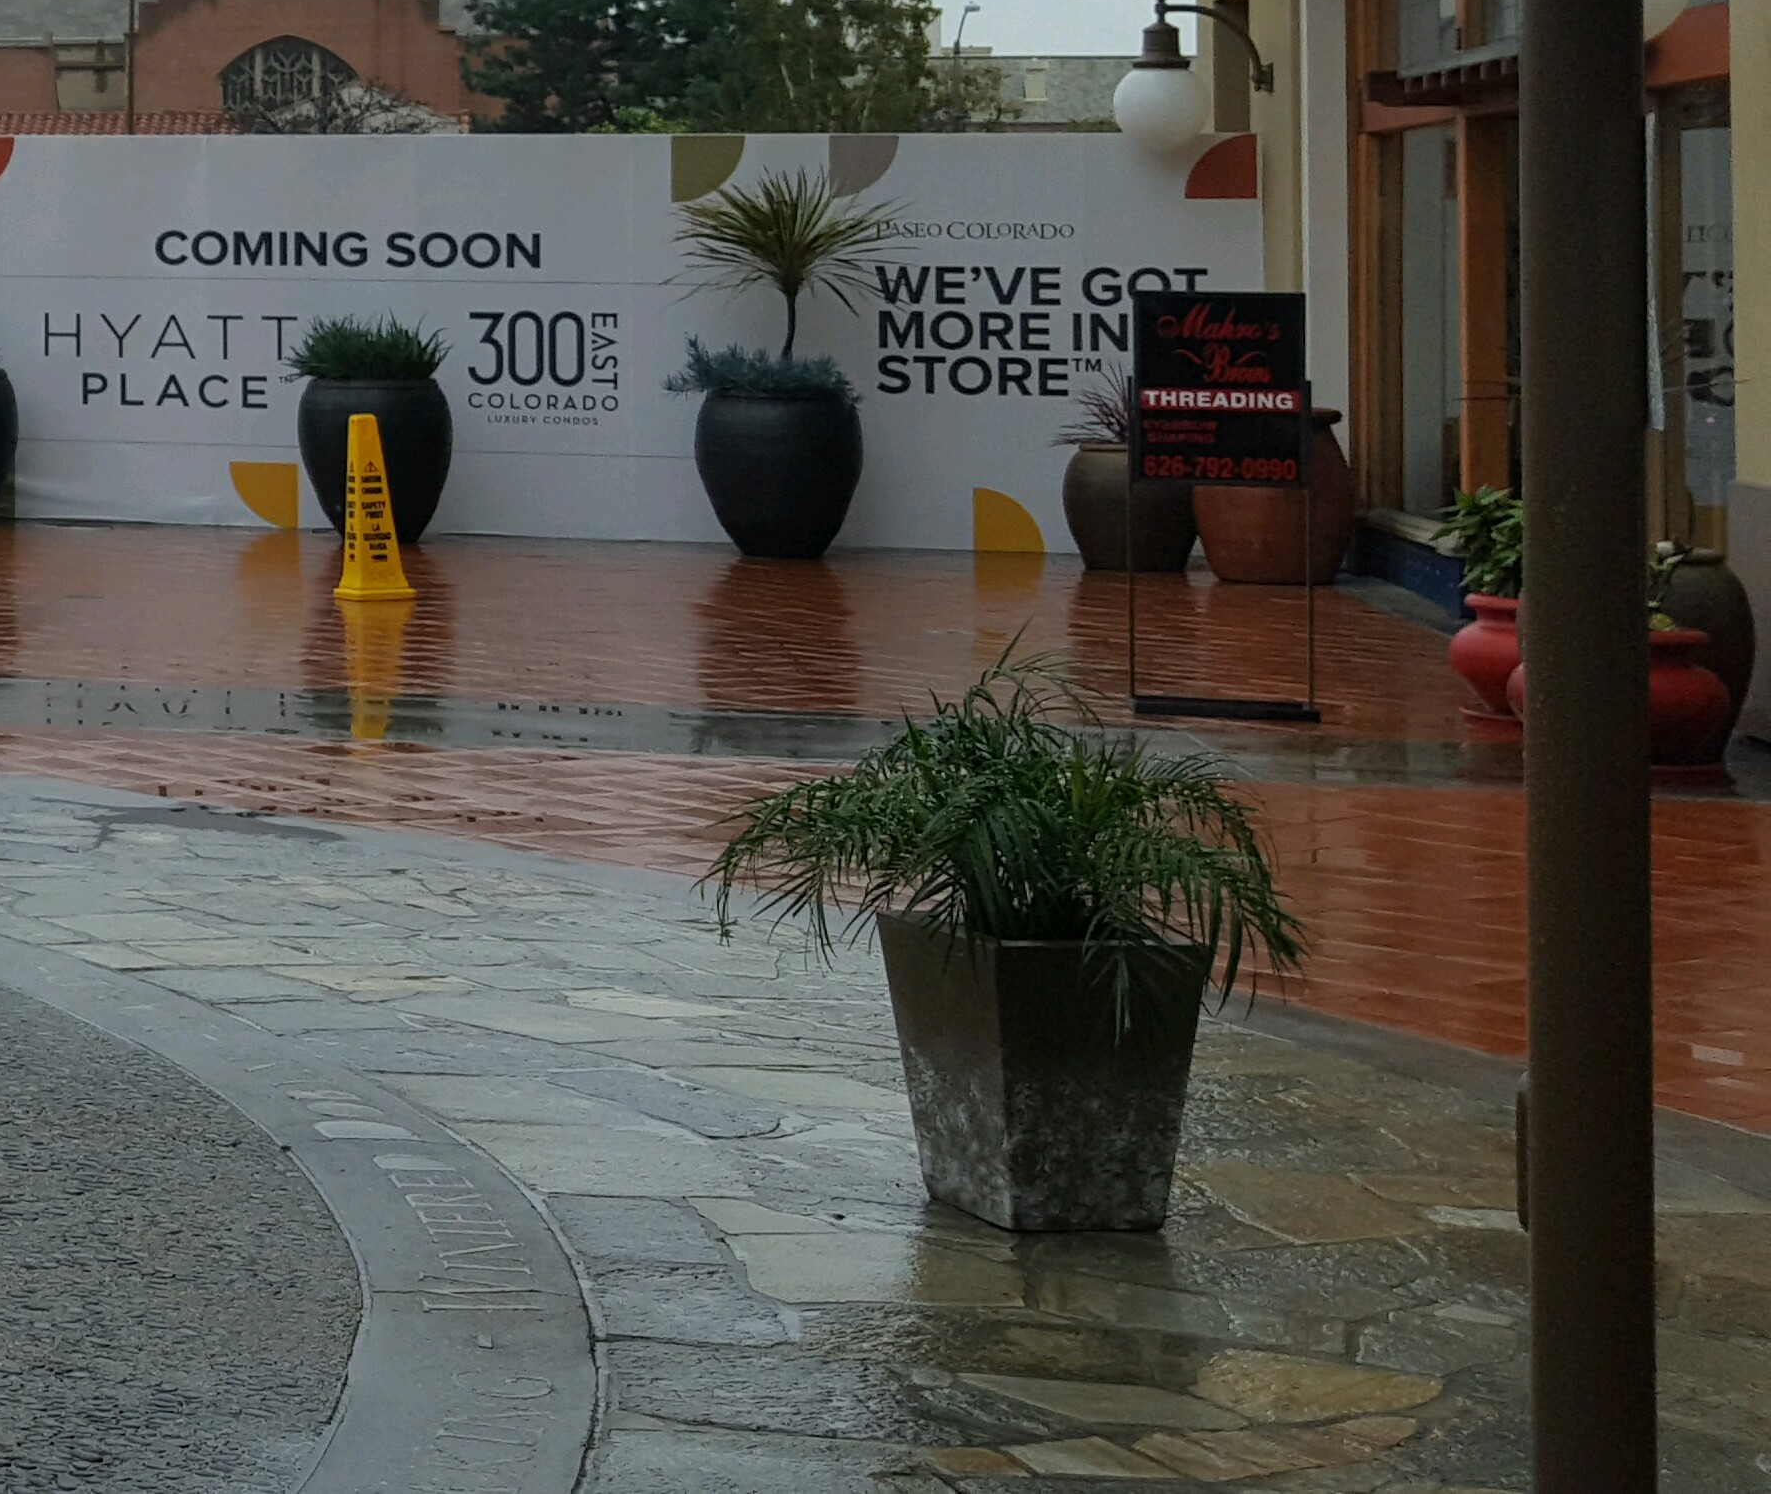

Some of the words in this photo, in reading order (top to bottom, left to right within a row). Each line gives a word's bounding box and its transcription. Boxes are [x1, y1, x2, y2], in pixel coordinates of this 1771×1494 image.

[155, 230, 369, 267] COMING
[386, 232, 543, 269] SOON
[876, 220, 942, 239] PASEO
[946, 221, 1075, 240] COLORADO
[875, 265, 1062, 306] WE'VE
[1081, 267, 1209, 307] GOT
[43, 312, 299, 361] HYATT
[468, 310, 586, 387] 300
[591, 312, 619, 390] EAST
[877, 310, 1051, 352] MORE
[1072, 313, 1129, 353] IN
[467, 392, 619, 412] COLORADO
[1144, 390, 1294, 410] THREADING
[487, 414, 537, 424] LUXURY
[543, 415, 599, 426] CONDOS
